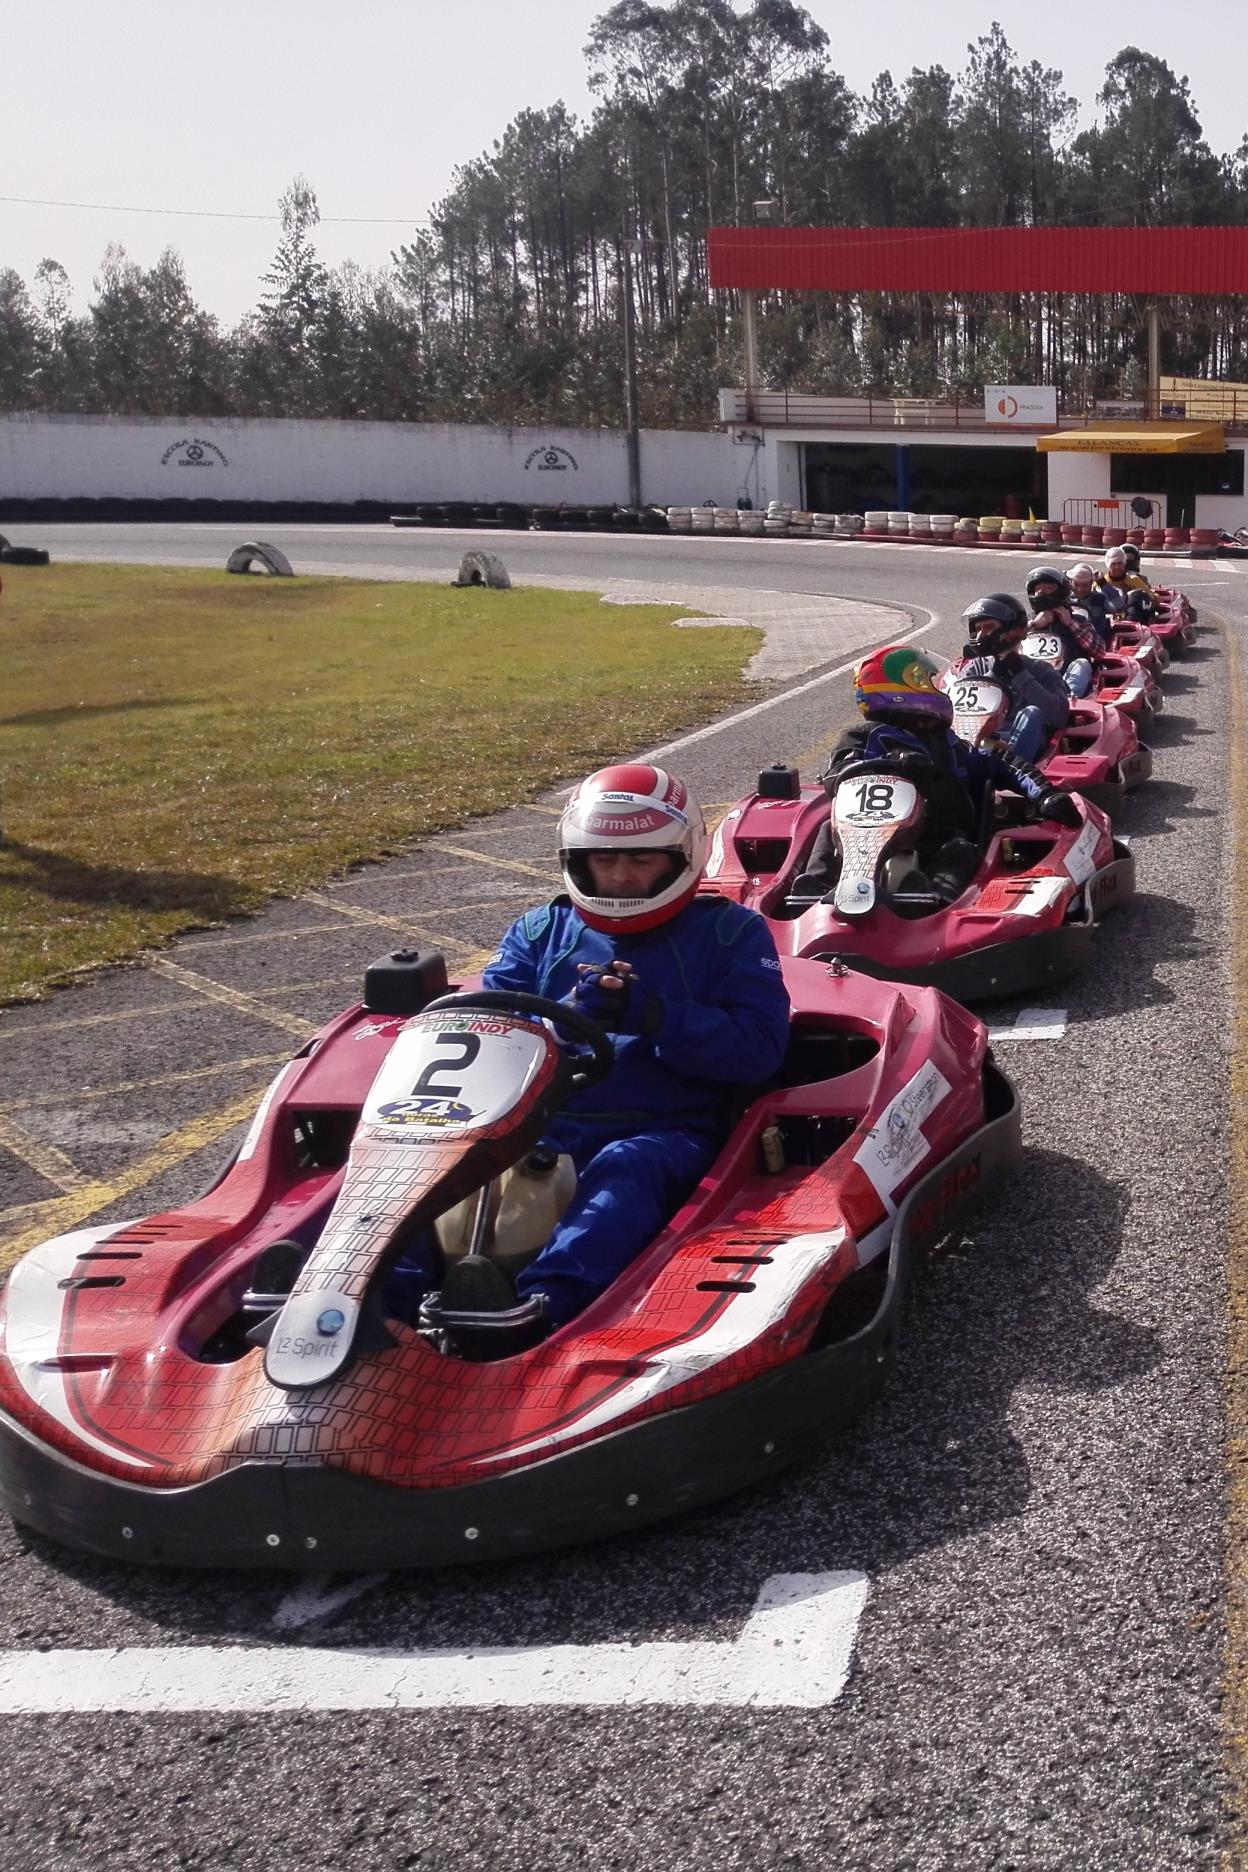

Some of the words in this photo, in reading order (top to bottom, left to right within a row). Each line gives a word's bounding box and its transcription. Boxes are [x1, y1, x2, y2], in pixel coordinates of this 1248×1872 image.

[161, 439, 189, 465] ESCOLA
[194, 439, 229, 467] KARTING
[524, 446, 546, 470] ESCOLA
[550, 445, 579, 470] KARTING
[1038, 638, 1059, 654] 23
[955, 686, 978, 708] 25
[855, 784, 894, 813] 18
[586, 815, 655, 831] parmalat
[421, 1021, 512, 1035] EUROINDY
[411, 1033, 481, 1098] 2
[389, 1100, 451, 1115] 24
[301, 1337, 338, 1358] Spirit
